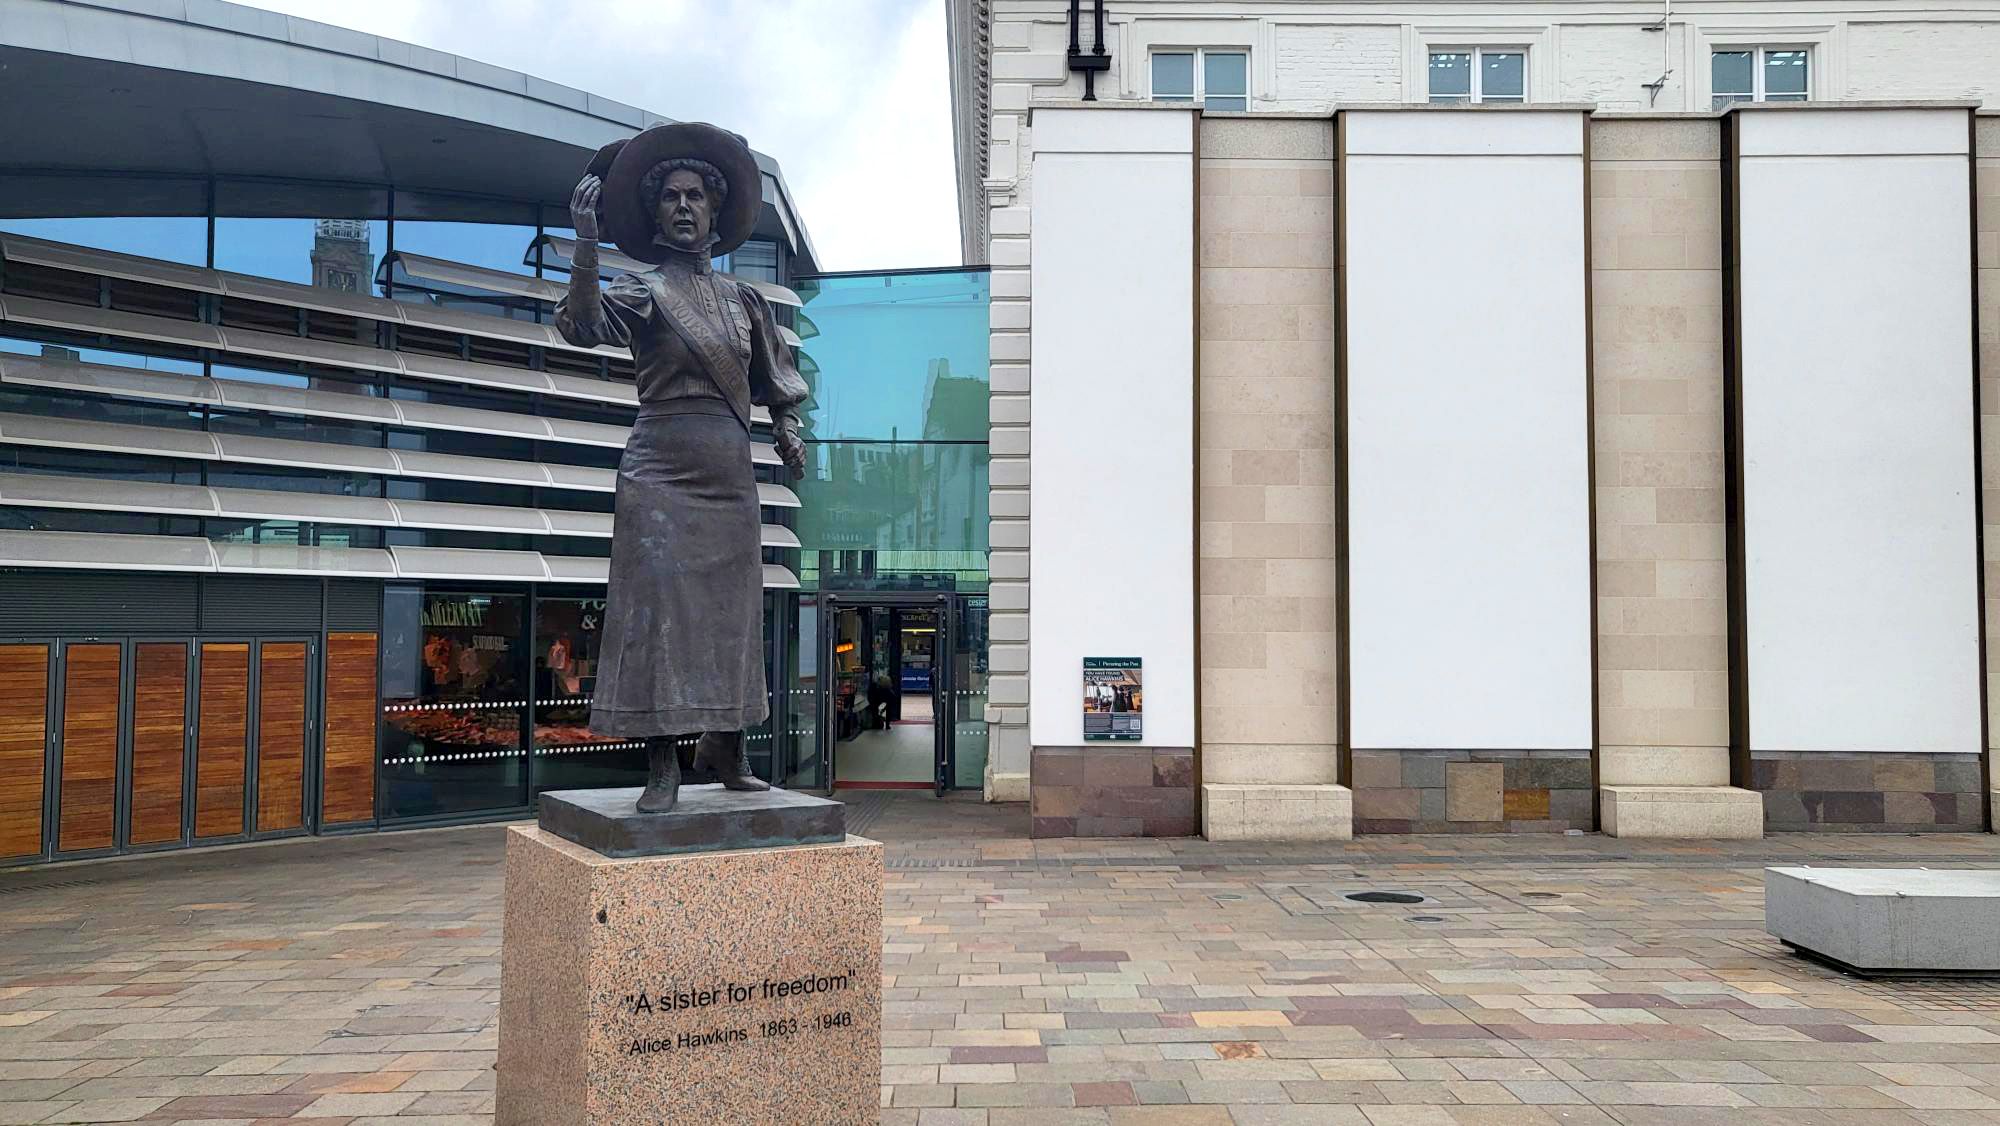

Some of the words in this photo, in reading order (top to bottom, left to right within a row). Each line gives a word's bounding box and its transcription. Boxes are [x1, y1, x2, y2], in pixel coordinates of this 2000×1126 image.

[671, 301, 711, 340] VOTES
[625, 992, 653, 1016] "A
[660, 987, 720, 1012] sister
[727, 982, 757, 1004] for
[762, 968, 857, 1000] freedom"
[629, 1036, 672, 1057] Alice
[677, 1027, 748, 1050] Hawkins
[759, 1018, 798, 1039] 1863
[815, 1011, 852, 1031] 1946
